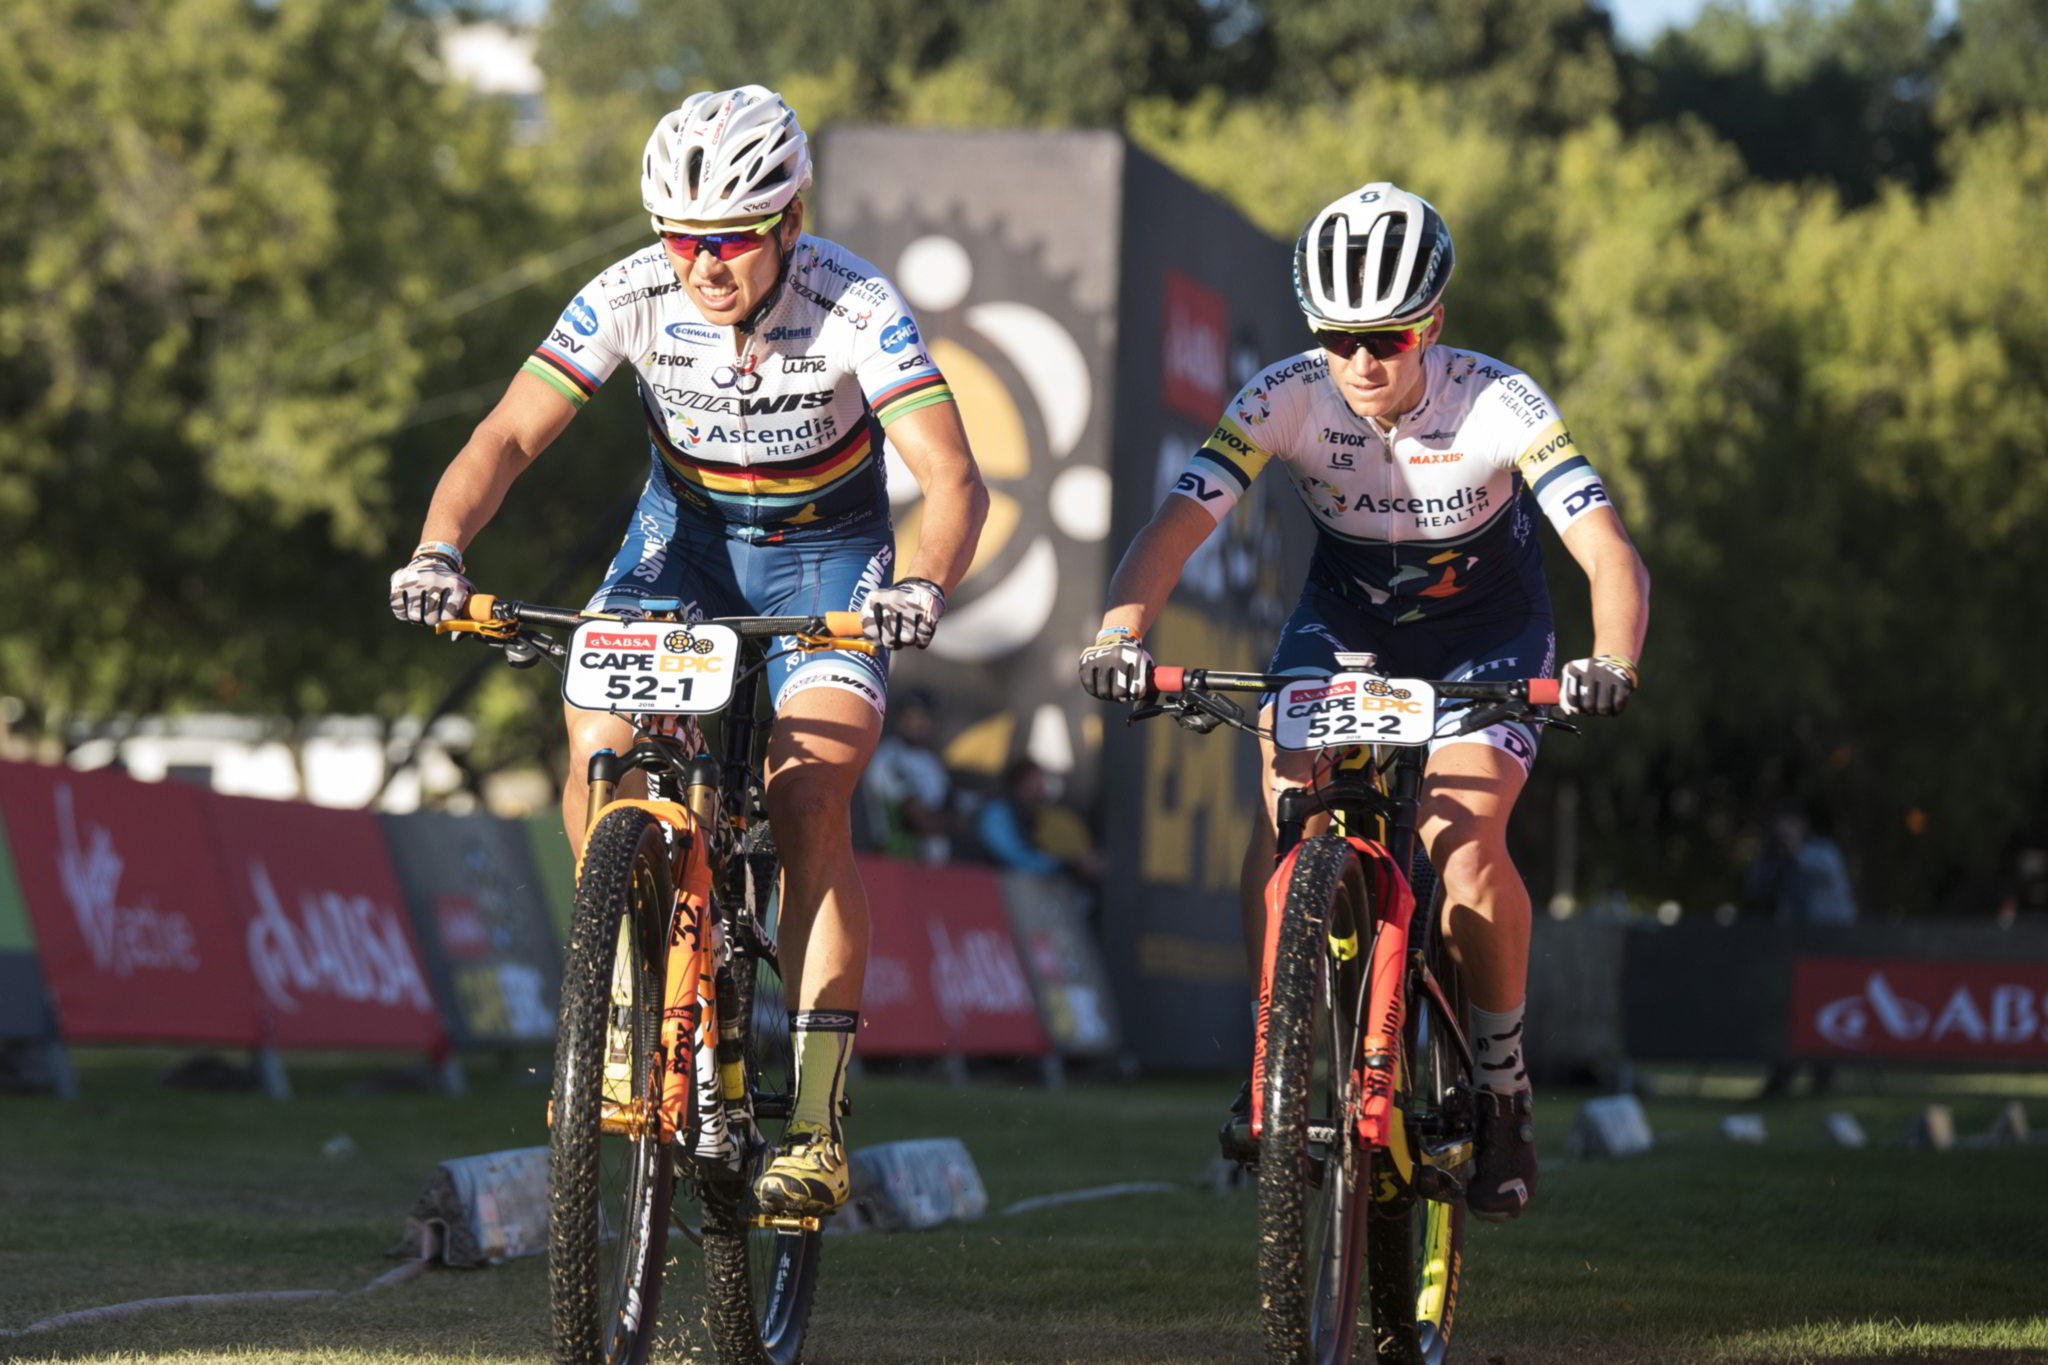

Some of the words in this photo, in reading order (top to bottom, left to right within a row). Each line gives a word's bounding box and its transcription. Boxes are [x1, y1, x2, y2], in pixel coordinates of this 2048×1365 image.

[820, 257, 889, 301] Ascendis
[843, 281, 881, 308] HEALTH
[658, 354, 694, 368] EVOX
[652, 383, 834, 417] WIAWIS
[1477, 365, 1549, 420] Ascendis
[1500, 392, 1536, 428] HEALTH
[706, 415, 835, 443] Ascendis
[766, 429, 838, 457] HEALTH
[1213, 426, 1256, 456] EVOX
[1329, 432, 1366, 447] EVOX
[1332, 452, 1354, 467] LS
[1408, 453, 1461, 465] MAXXIS
[1537, 431, 1574, 462] EVOX
[1177, 471, 1224, 501] SV
[1353, 486, 1488, 514] Ascendis
[1415, 499, 1490, 528] HEALTH
[1562, 483, 1607, 518] DS
[611, 638, 651, 648] ABSA
[580, 652, 655, 672] CAPE
[659, 655, 724, 673] EPIC
[605, 675, 693, 701] 52-1
[1287, 697, 1355, 718] CAPE
[1362, 697, 1422, 714] EPIC
[1307, 715, 1401, 738] 52-2
